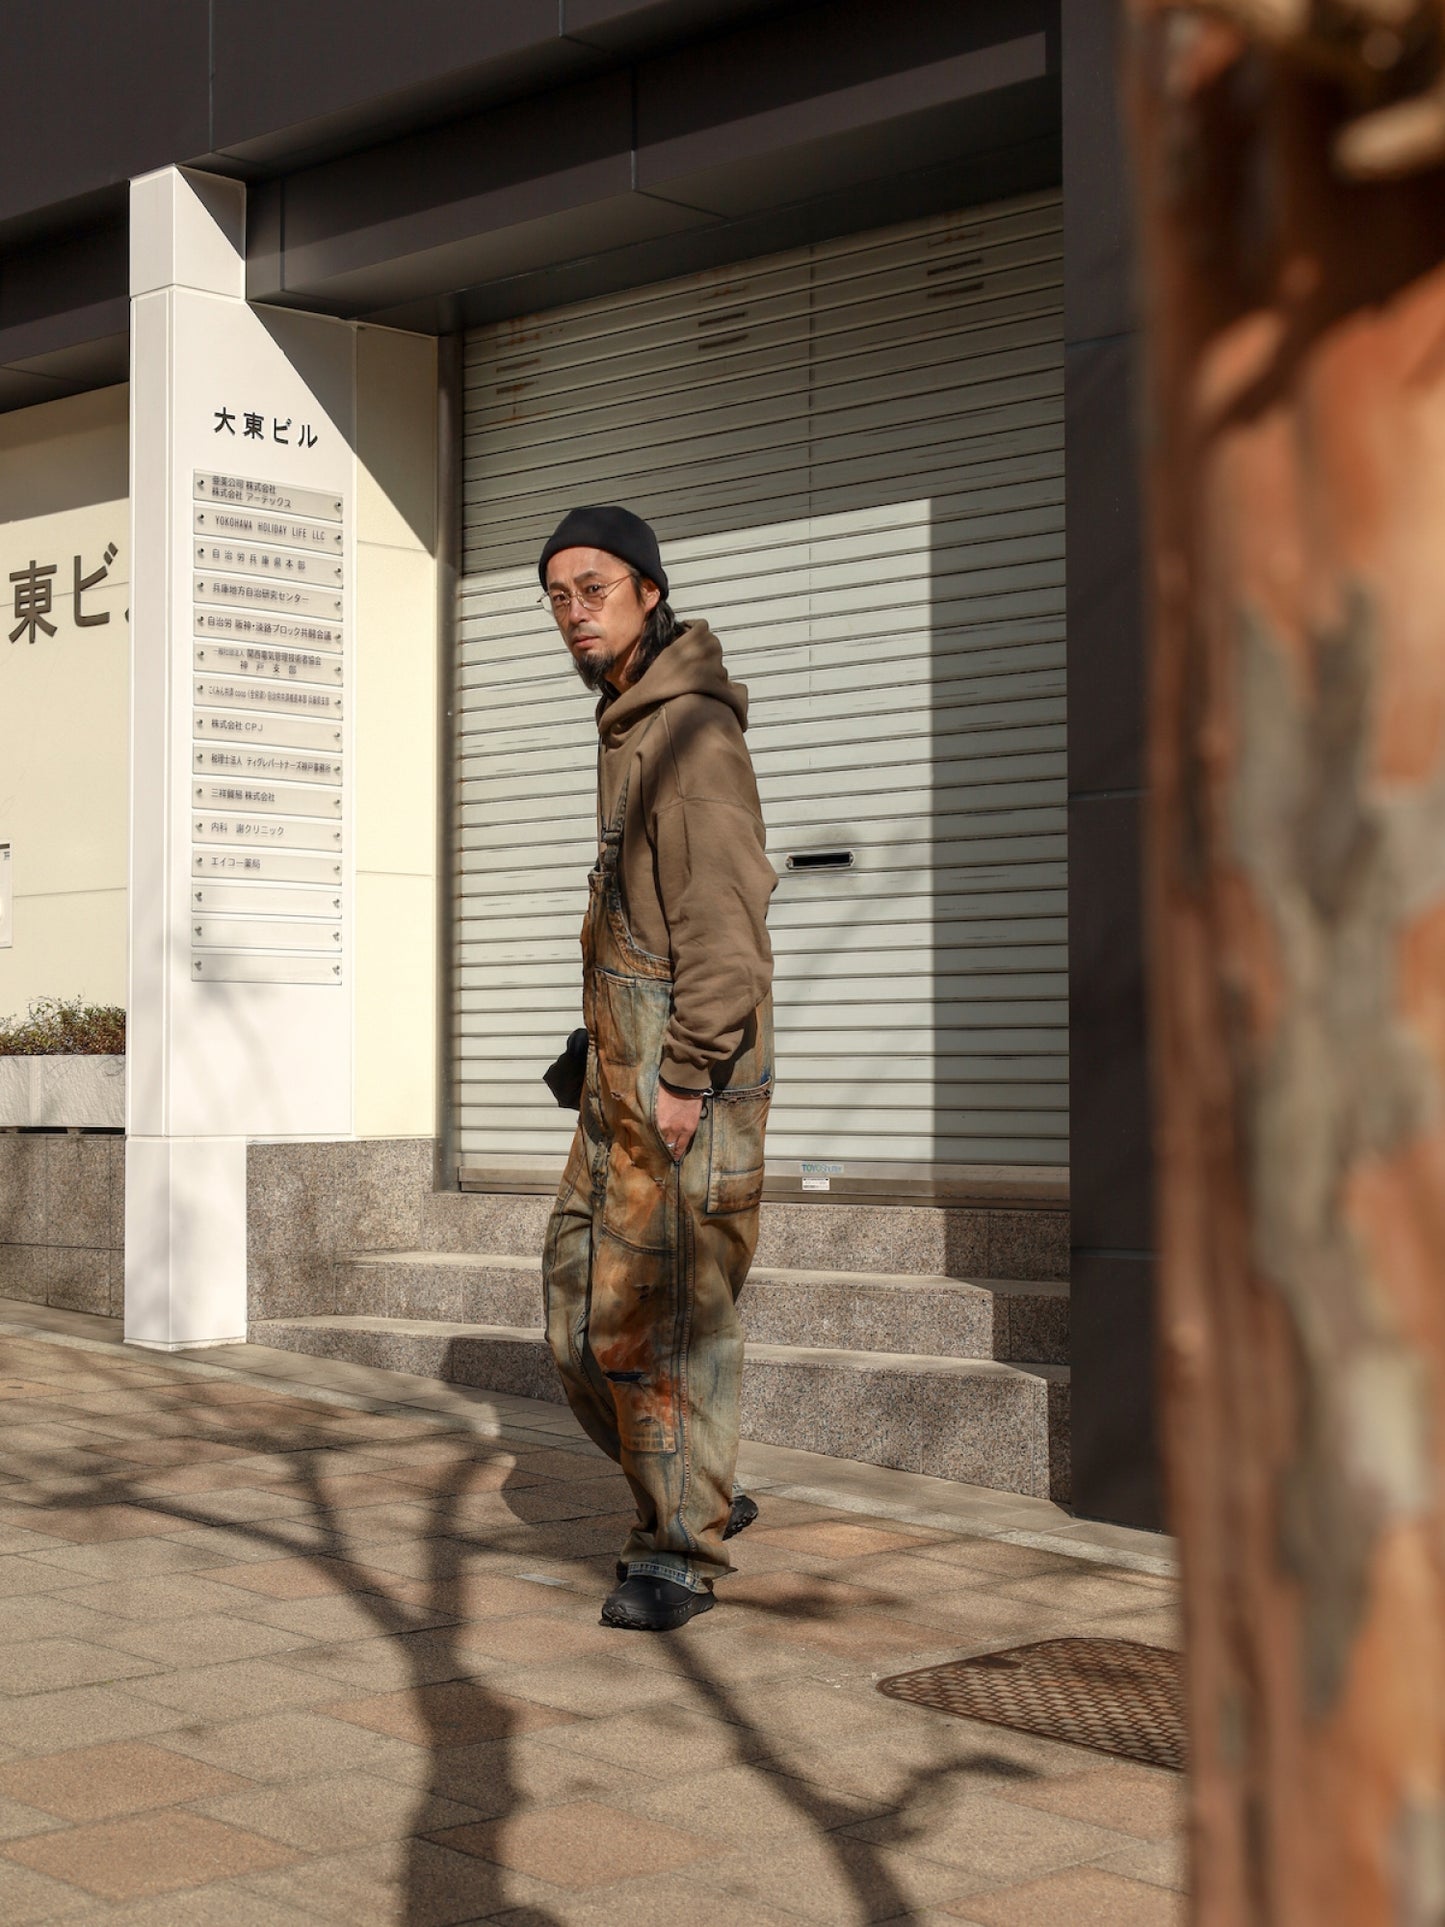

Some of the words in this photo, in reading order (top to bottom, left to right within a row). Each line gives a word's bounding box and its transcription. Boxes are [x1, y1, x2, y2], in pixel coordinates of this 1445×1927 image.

[214, 406, 318, 449] 大東ビル
[245, 481, 276, 495] 株式会社
[212, 487, 243, 501] 株式会社
[246, 492, 292, 509] アーテックス
[215, 514, 252, 530] YOKOHAMA
[258, 521, 287, 536] HOLIDAY
[292, 527, 307, 539] LIFE
[312, 530, 325, 541] LLC
[8, 542, 130, 645] 東ビ
[212, 582, 310, 603] 兵庫地方自治研究センター
[207, 615, 233, 630] 自治労
[211, 718, 243, 732] 株式会社
[244, 722, 264, 733] CPJ
[211, 752, 243, 767] 税理士法人
[244, 789, 276, 803] 株式会社
[210, 821, 228, 834] 内科
